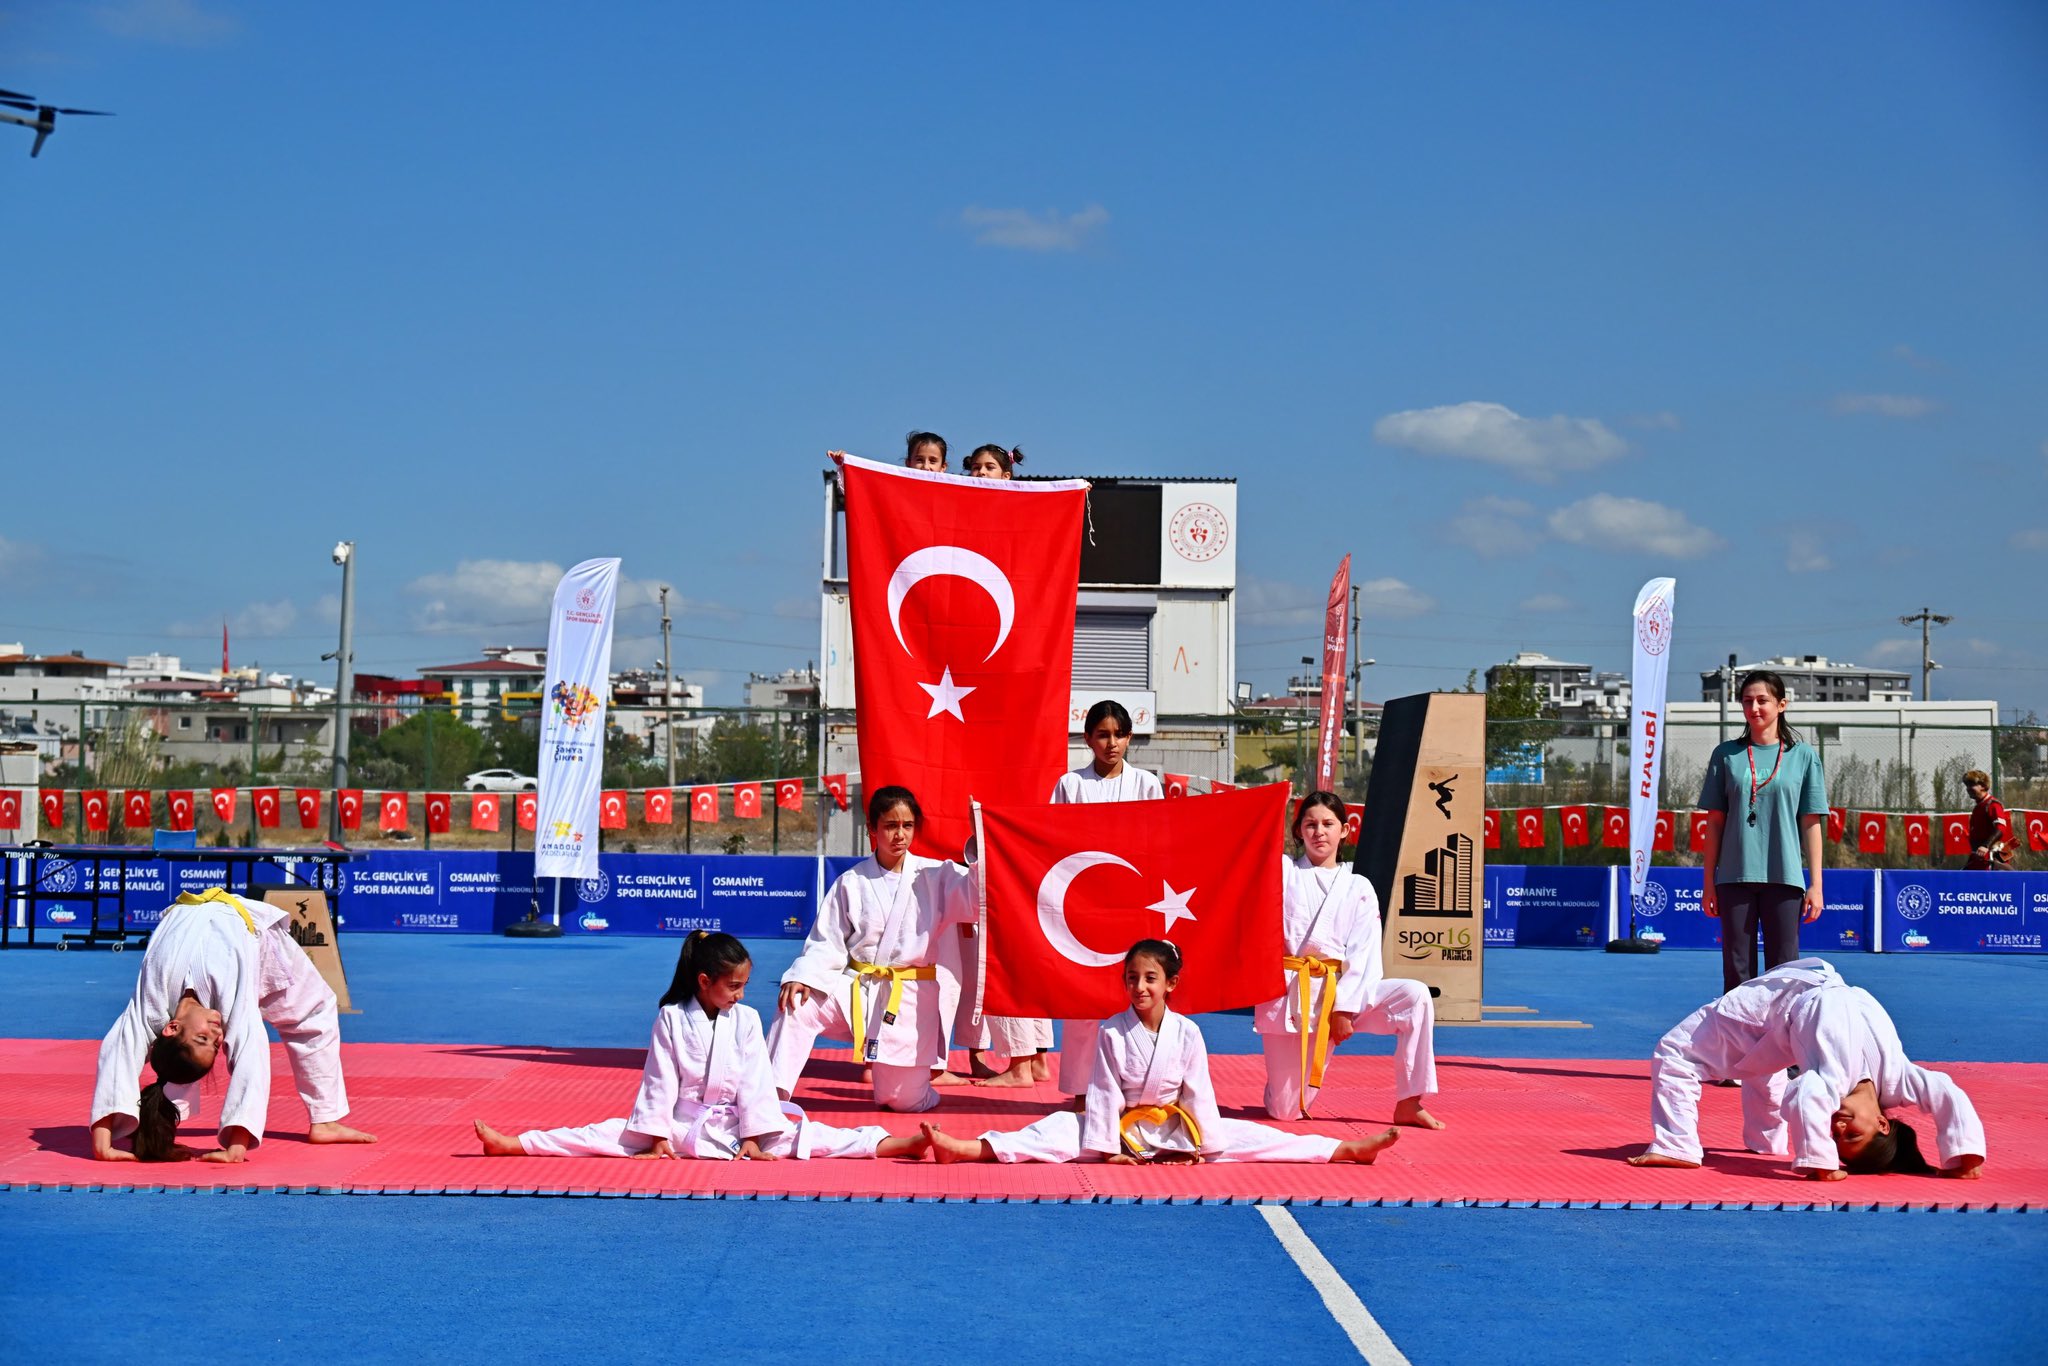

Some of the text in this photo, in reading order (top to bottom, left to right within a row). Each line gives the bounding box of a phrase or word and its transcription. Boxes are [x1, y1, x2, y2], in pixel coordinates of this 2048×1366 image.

[1641, 711, 1657, 798] RAGBİ
[146, 868, 159, 878] VE
[180, 868, 227, 879] OSMANİY
[353, 871, 428, 883] T.C. GENÇLİK VE
[450, 871, 501, 882] OSMANİYE
[112, 880, 164, 891] BKANLIĞI
[617, 874, 691, 887] T.C. GENÇLİK VE
[713, 875, 764, 887] OSMANİYE
[353, 884, 434, 895] SPOR BAKANLIĞI
[450, 885, 474, 894] GENÇLİK
[617, 887, 697, 899] SPOR BAKANLIĞI
[713, 889, 737, 898] GENÇLİK
[747, 890, 763, 898] SPOR
[1507, 887, 1557, 898] OSMANİYE
[1674, 889, 1692, 899] T.C.
[1939, 891, 2012, 904] T.C. GENÇLİK VE
[1507, 900, 1531, 908] GENÇLİK
[1674, 902, 1700, 911] SPOR
[1938, 905, 2018, 915] SPOR BAKANLIĞI
